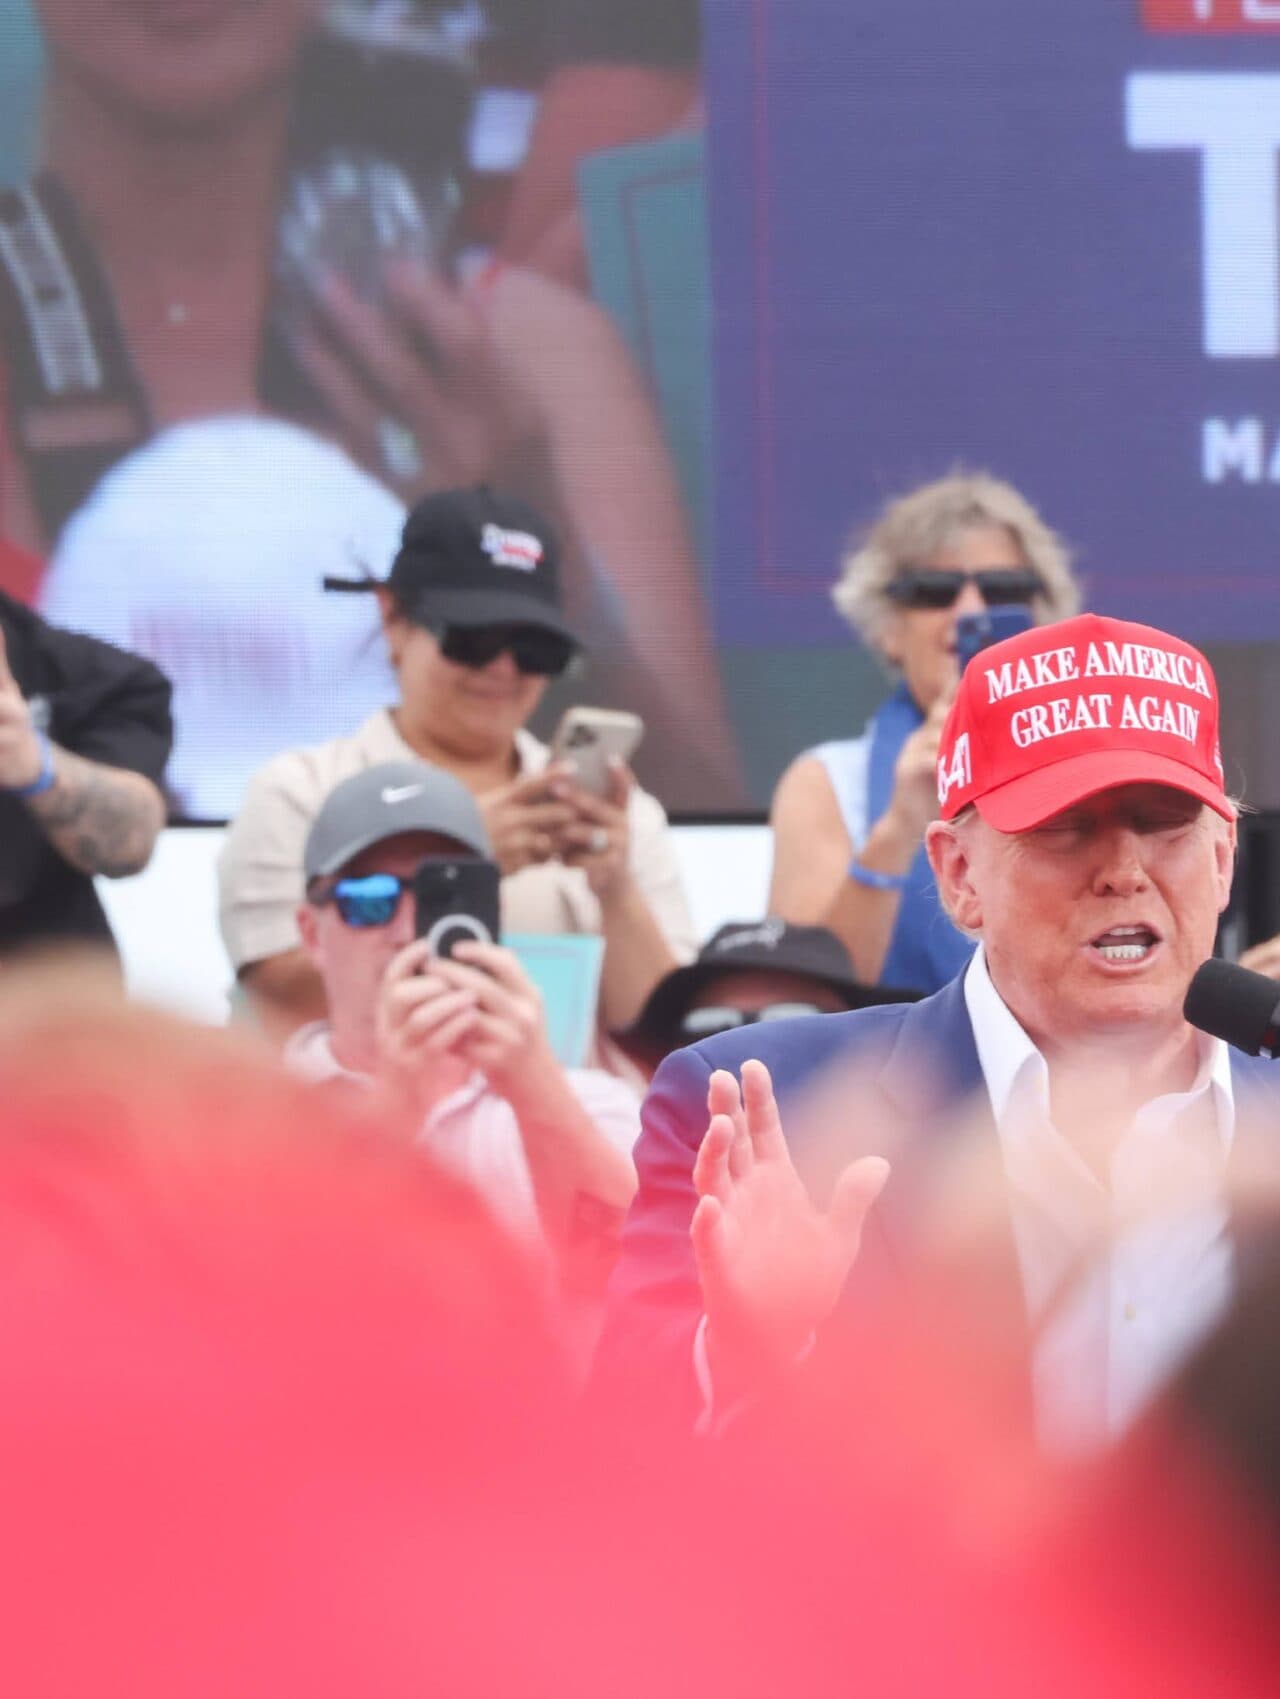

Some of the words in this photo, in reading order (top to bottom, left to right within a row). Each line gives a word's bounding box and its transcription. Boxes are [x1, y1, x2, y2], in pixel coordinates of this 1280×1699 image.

[984, 646, 1079, 704] MAKE
[1084, 641, 1211, 699] AMERICA
[1010, 694, 1112, 748] GREAT
[1119, 694, 1199, 746] AGAIN
